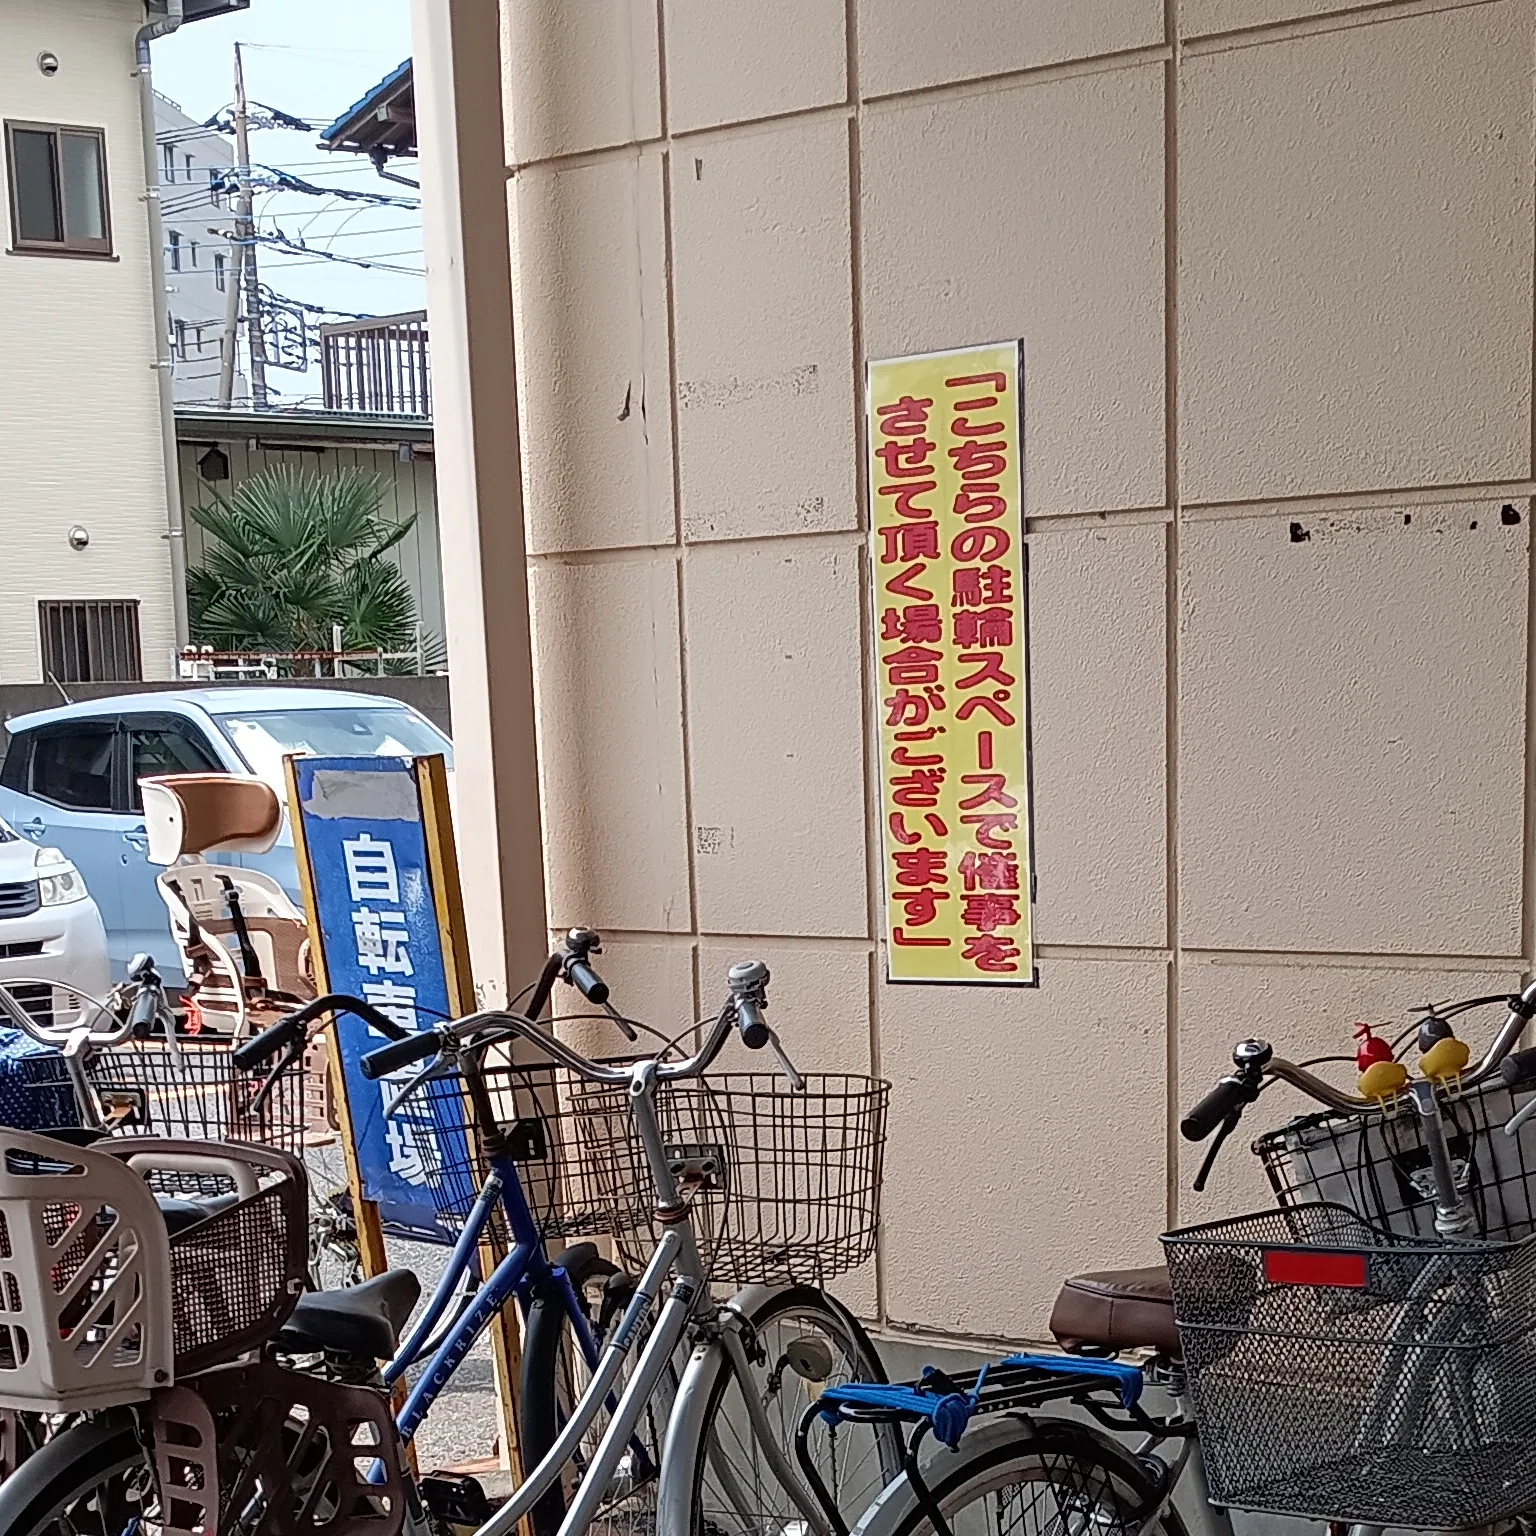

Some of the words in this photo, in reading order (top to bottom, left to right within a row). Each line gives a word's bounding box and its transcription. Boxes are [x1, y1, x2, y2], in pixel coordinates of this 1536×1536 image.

[874, 395, 952, 949] させて頂く場合がございます」
